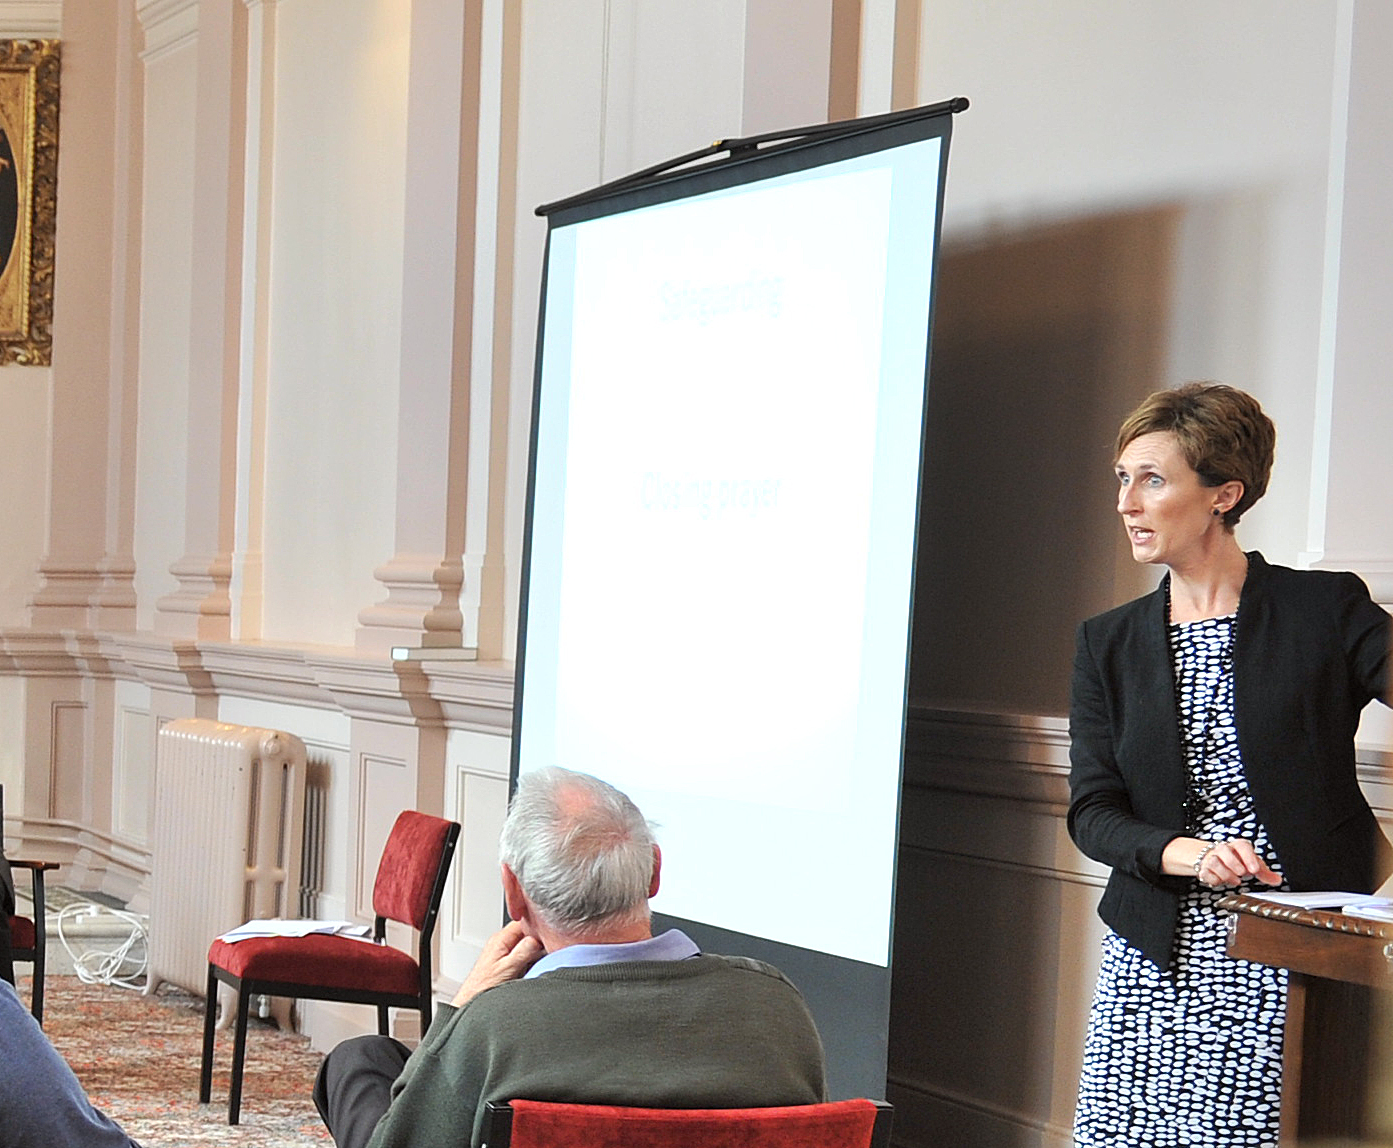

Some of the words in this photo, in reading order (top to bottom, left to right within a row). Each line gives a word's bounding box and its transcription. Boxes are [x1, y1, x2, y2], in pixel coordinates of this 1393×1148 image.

[658, 271, 784, 327] Safeguarding
[642, 472, 713, 520] Closing
[717, 478, 781, 520] prayer
